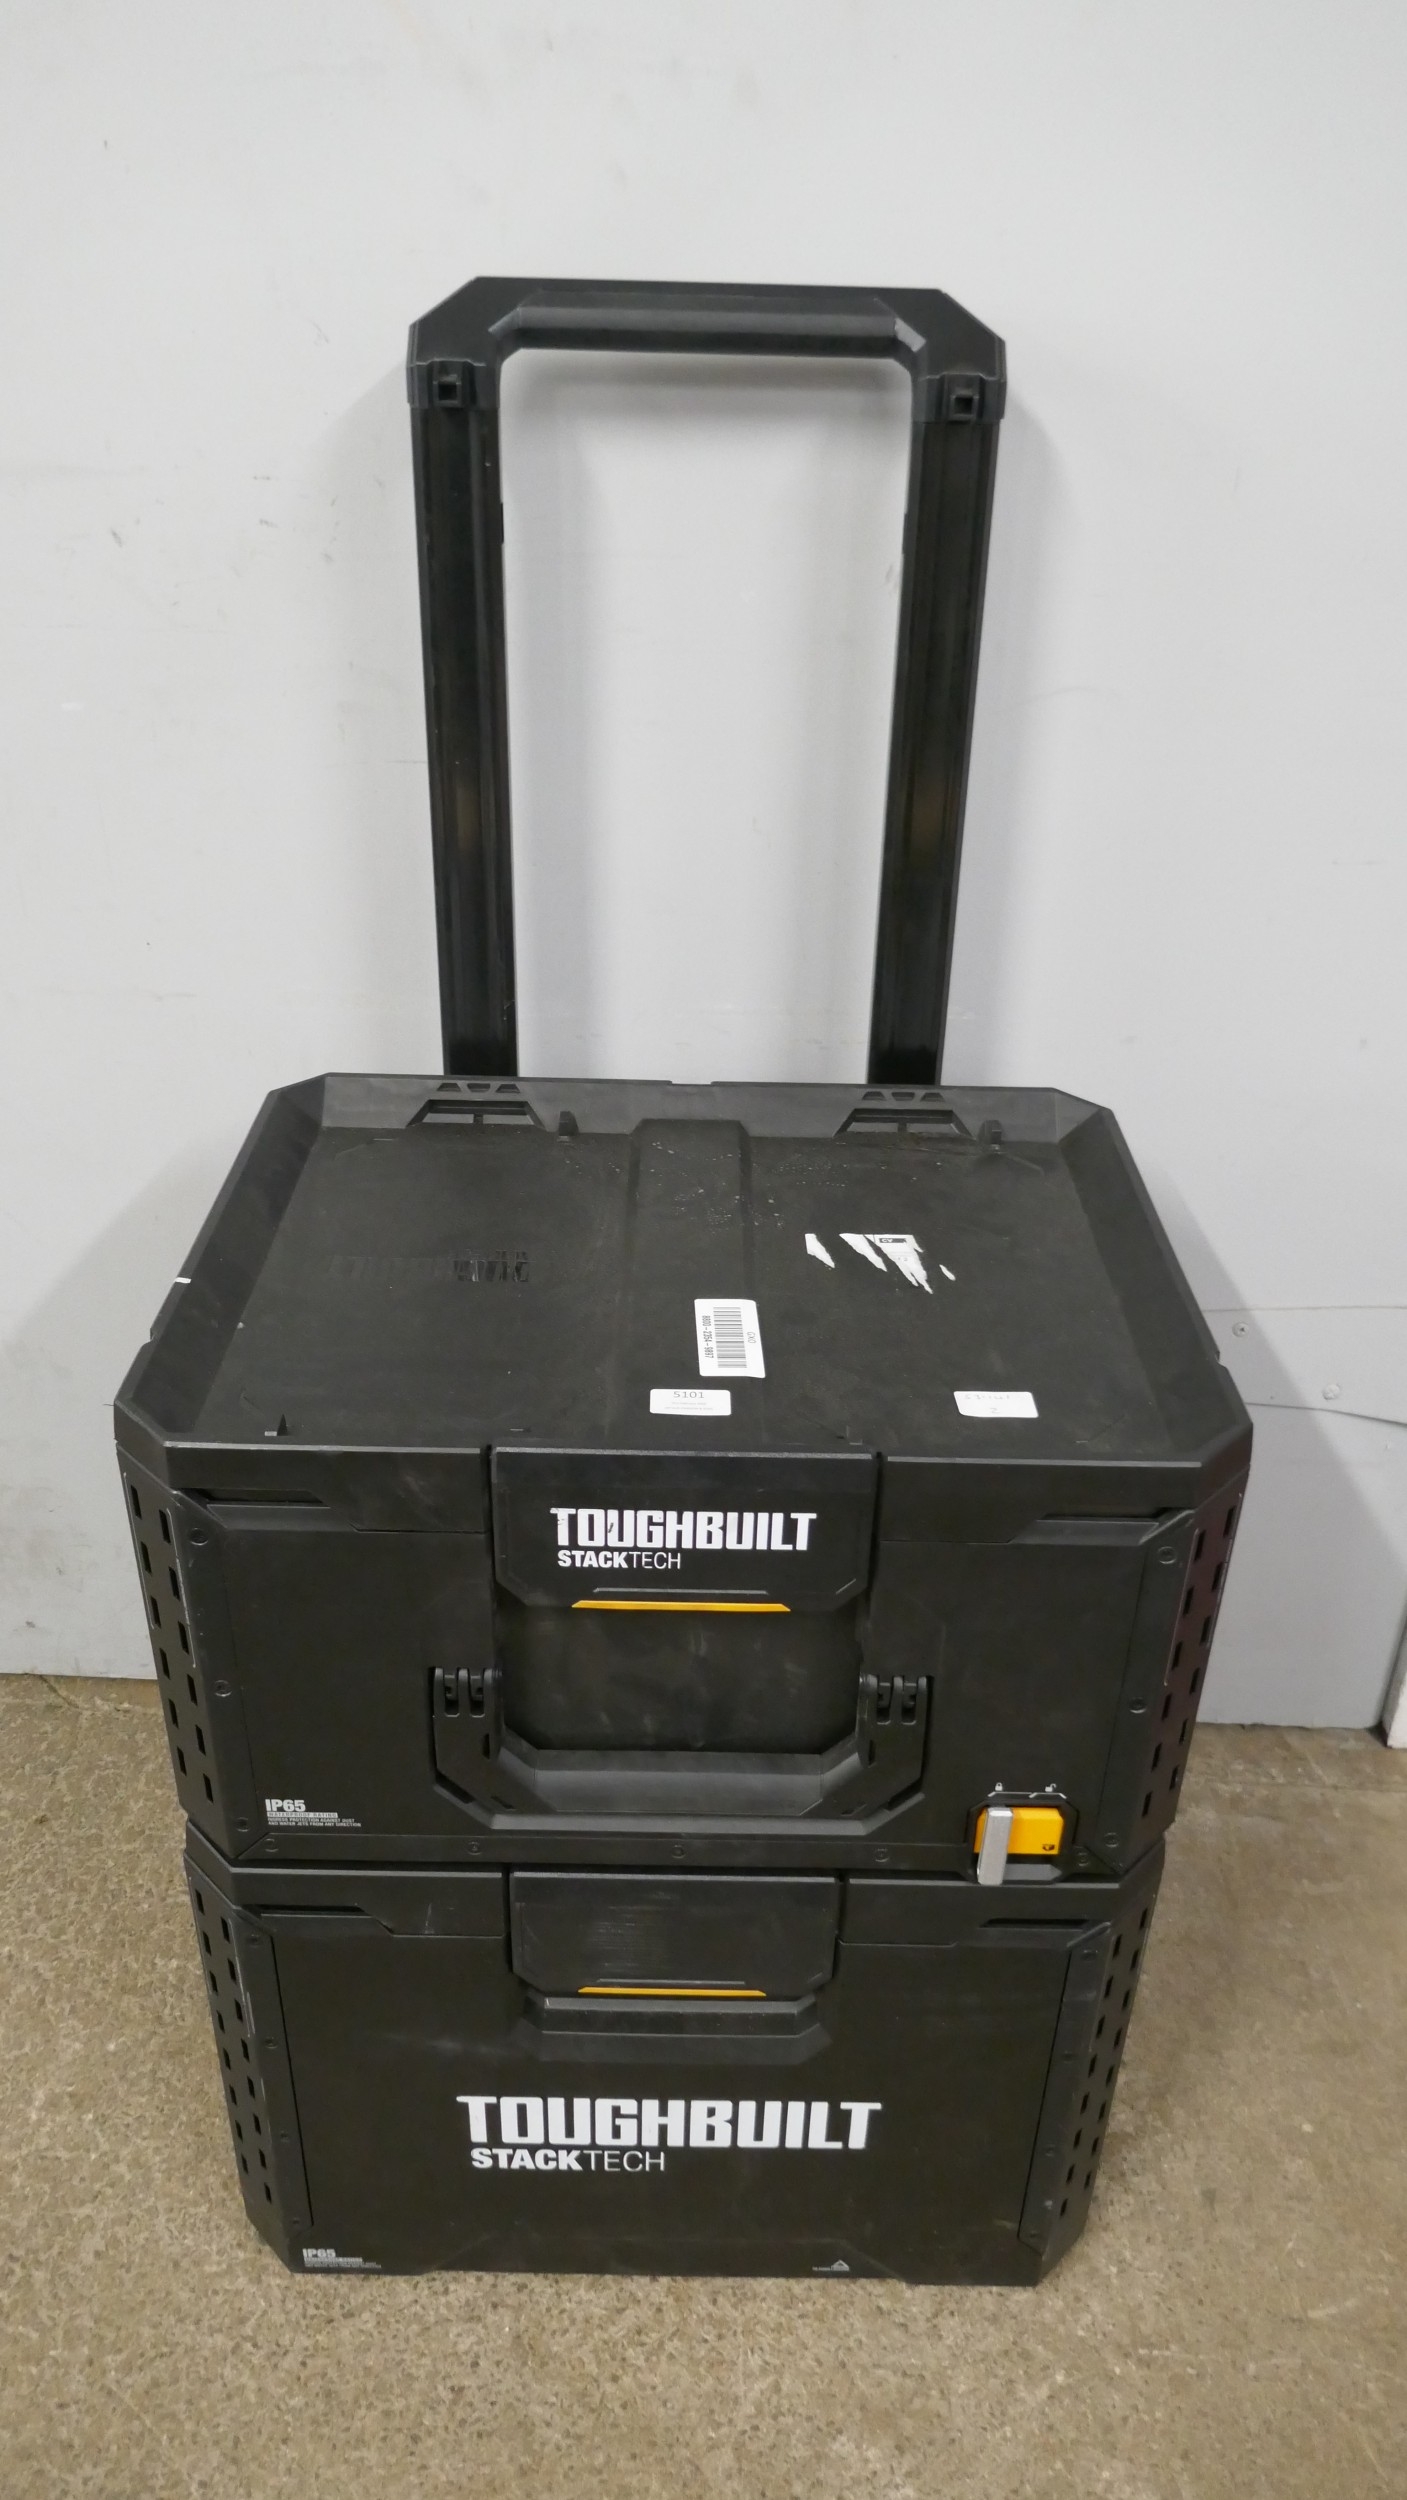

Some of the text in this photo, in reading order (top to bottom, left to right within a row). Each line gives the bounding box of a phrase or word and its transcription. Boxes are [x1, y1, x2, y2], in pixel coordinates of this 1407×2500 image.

[747, 1332, 757, 1343] GXO
[673, 1391, 705, 1399] 5101
[550, 1507, 817, 1551] TOUGHBUILT
[557, 1550, 681, 1569] STACKTECH
[265, 1799, 306, 1812] IP65
[456, 2095, 882, 2149] TOUGHBUILT
[470, 2148, 665, 2171] STACKTECH
